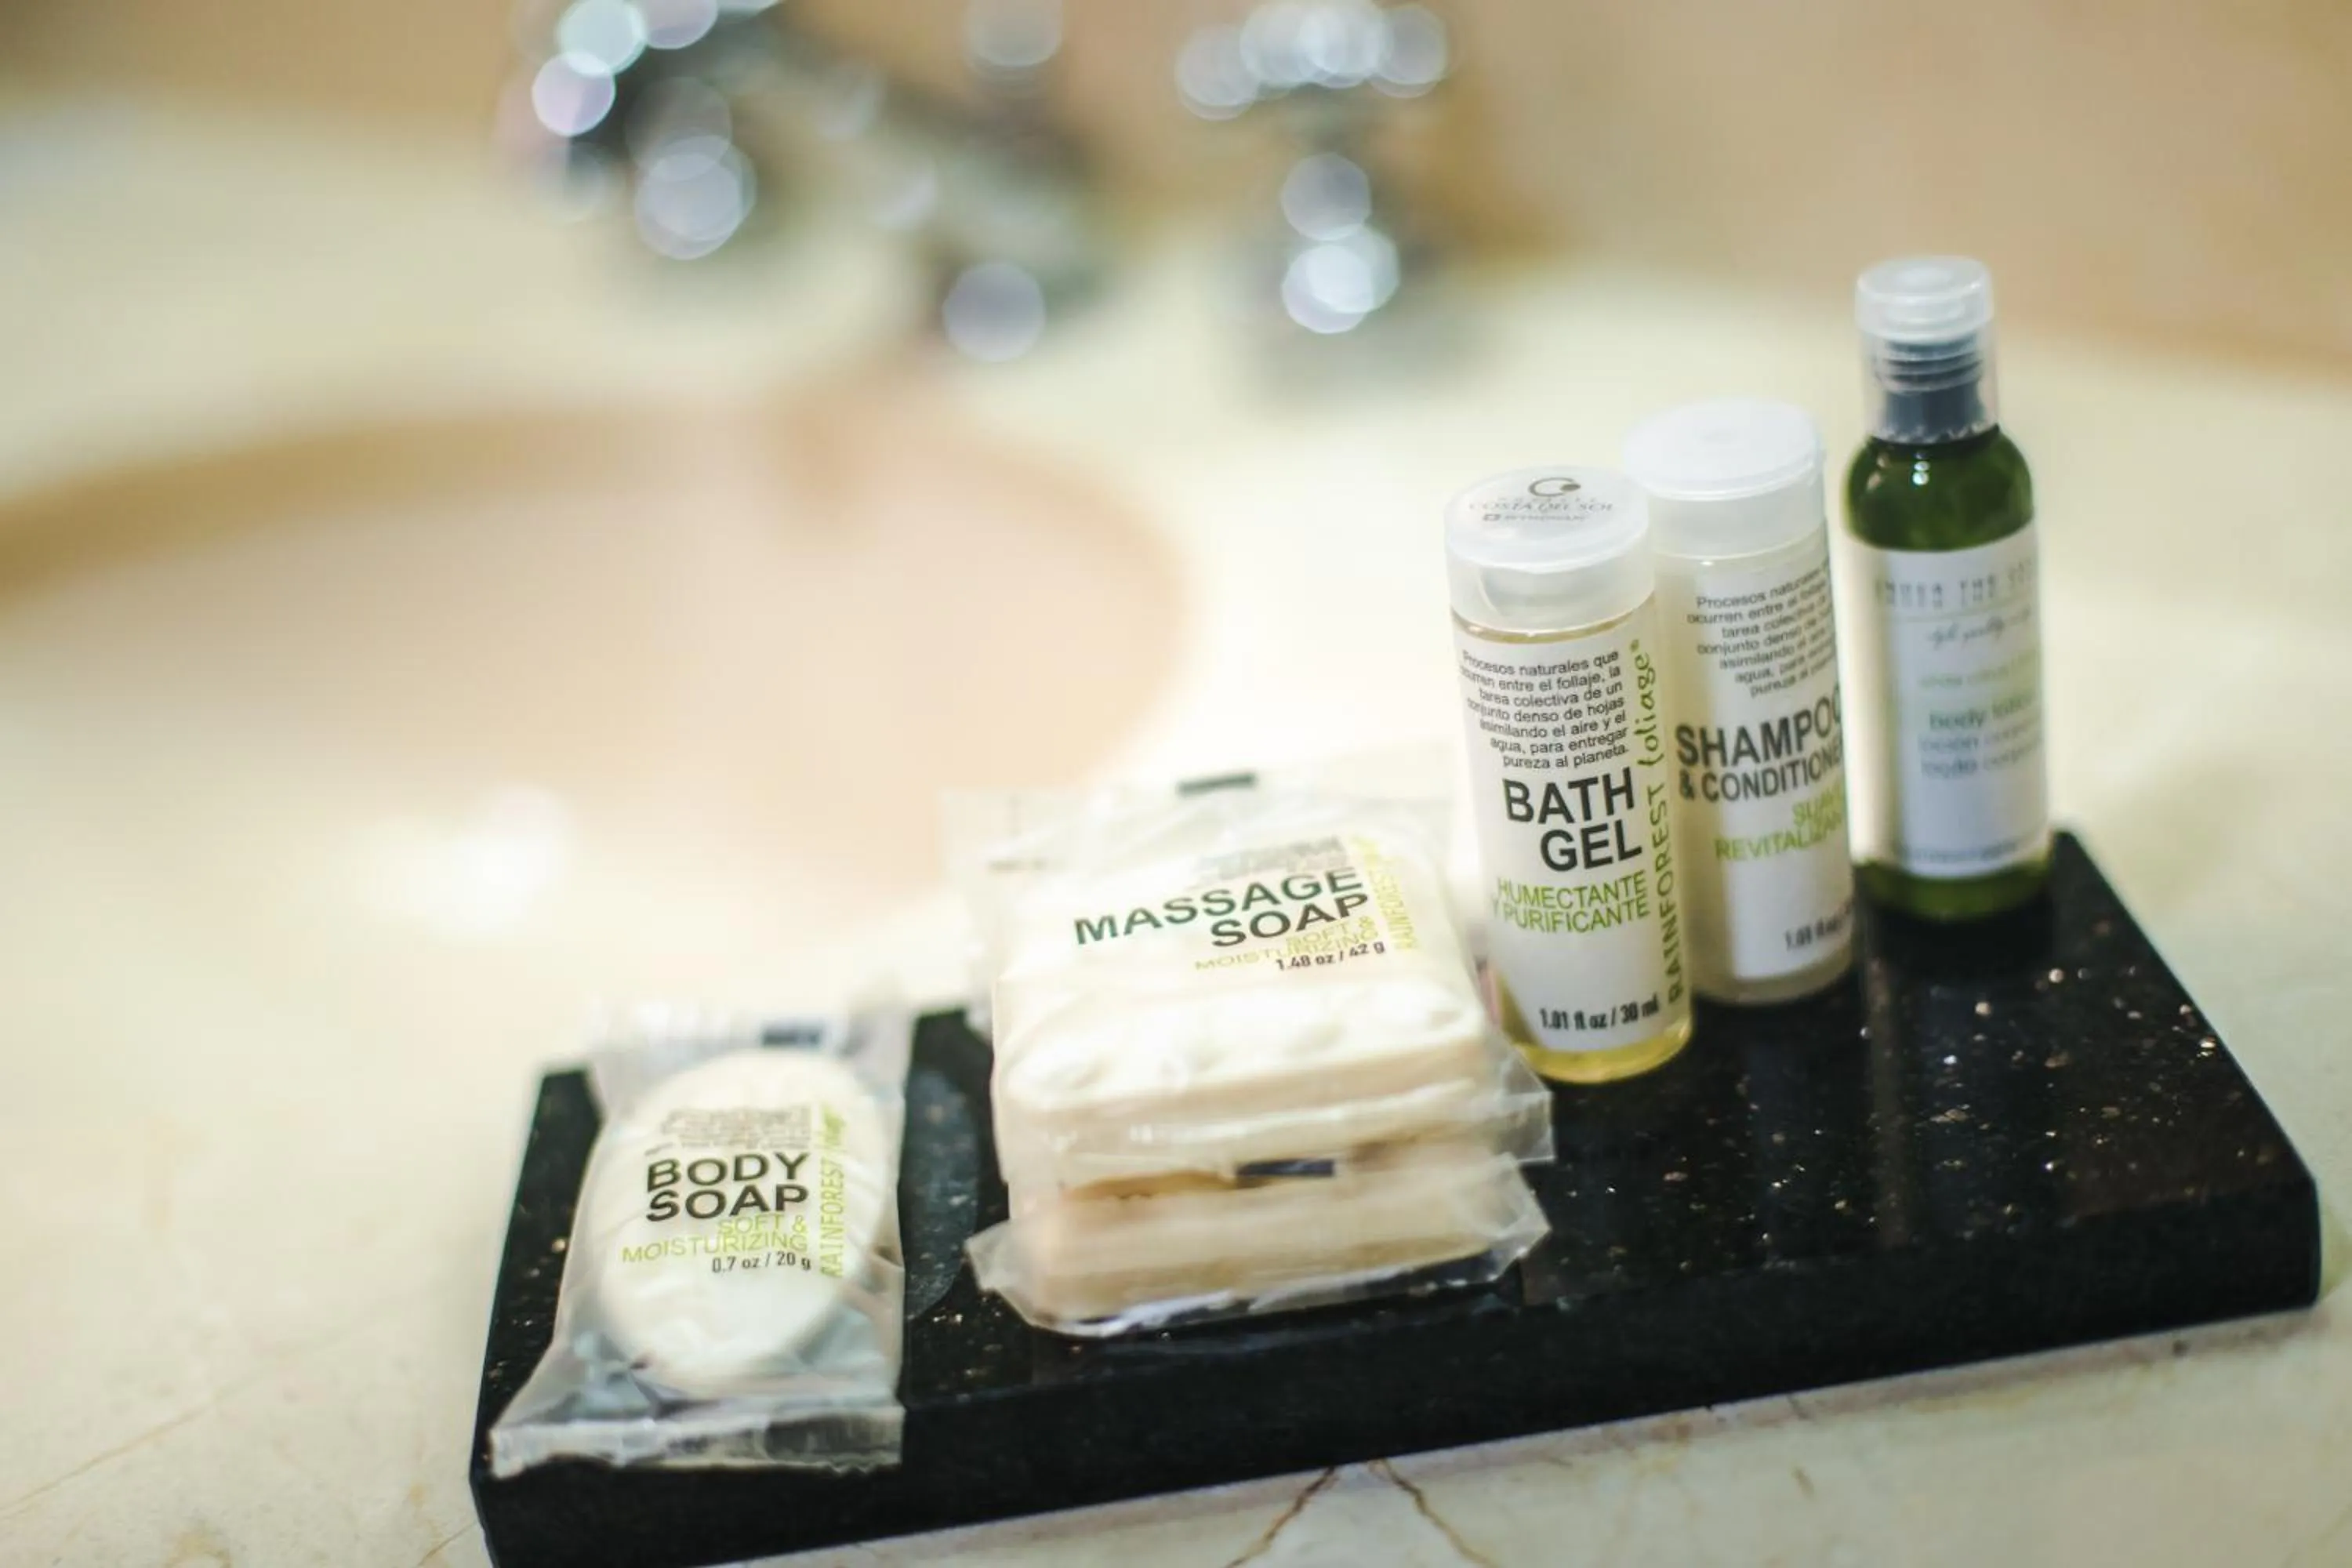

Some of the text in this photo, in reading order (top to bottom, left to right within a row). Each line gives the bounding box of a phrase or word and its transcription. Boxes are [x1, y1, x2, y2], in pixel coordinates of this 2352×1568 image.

[1686, 611, 1744, 624] ocurren
[1748, 602, 1784, 619] entre
[1697, 591, 1766, 608] Procesos
[1722, 625, 1760, 638] tarea
[1697, 639, 1760, 656] conjunto
[1463, 649, 1619, 676] Procesos naturales que
[1499, 679, 1534, 692] entre
[1539, 680, 1552, 692] el
[1557, 673, 1606, 689] follaje,
[1609, 666, 1621, 678] la
[1479, 681, 1622, 707] tarea colectiva de un
[1514, 710, 1559, 722] denso
[1563, 707, 1582, 720] de
[1587, 697, 1625, 716] hojas
[1552, 725, 1566, 737] el
[1570, 721, 1599, 735] aire
[1603, 718, 1611, 731] y
[1615, 710, 1626, 724] el
[1490, 728, 1628, 755] agua, para entregar
[1503, 744, 1629, 769] pureza al planeta.
[1502, 767, 1635, 825] BATH
[1679, 768, 1696, 800] &
[1541, 818, 1642, 872] GEL
[1497, 869, 1646, 909] HUMECTANTE
[1648, 784, 1684, 1006] RAINFOREST
[1073, 866, 1363, 945] MASSAGE
[1501, 898, 1650, 933] PURIFICANTE
[1210, 893, 1368, 947] SOAP
[1195, 929, 1378, 971] MOISTURIZING
[1276, 954, 1311, 971] 1.48
[1316, 954, 1334, 965] oz
[1349, 943, 1369, 956] 42
[1374, 941, 1385, 953] g
[1540, 1007, 1569, 1029] 1.01
[1589, 1014, 1606, 1029] oz
[1611, 1007, 1616, 1026] /
[1621, 1002, 1638, 1024] 30
[647, 1152, 810, 1192] BODY
[646, 1185, 808, 1221] SOAP
[717, 1214, 808, 1234] SOFT &
[820, 1158, 844, 1278] RAINFOREST
[622, 1232, 808, 1263] MOISTURIZING
[742, 1256, 760, 1268] oz
[777, 1251, 796, 1266] 20
[800, 1256, 811, 1270] g
